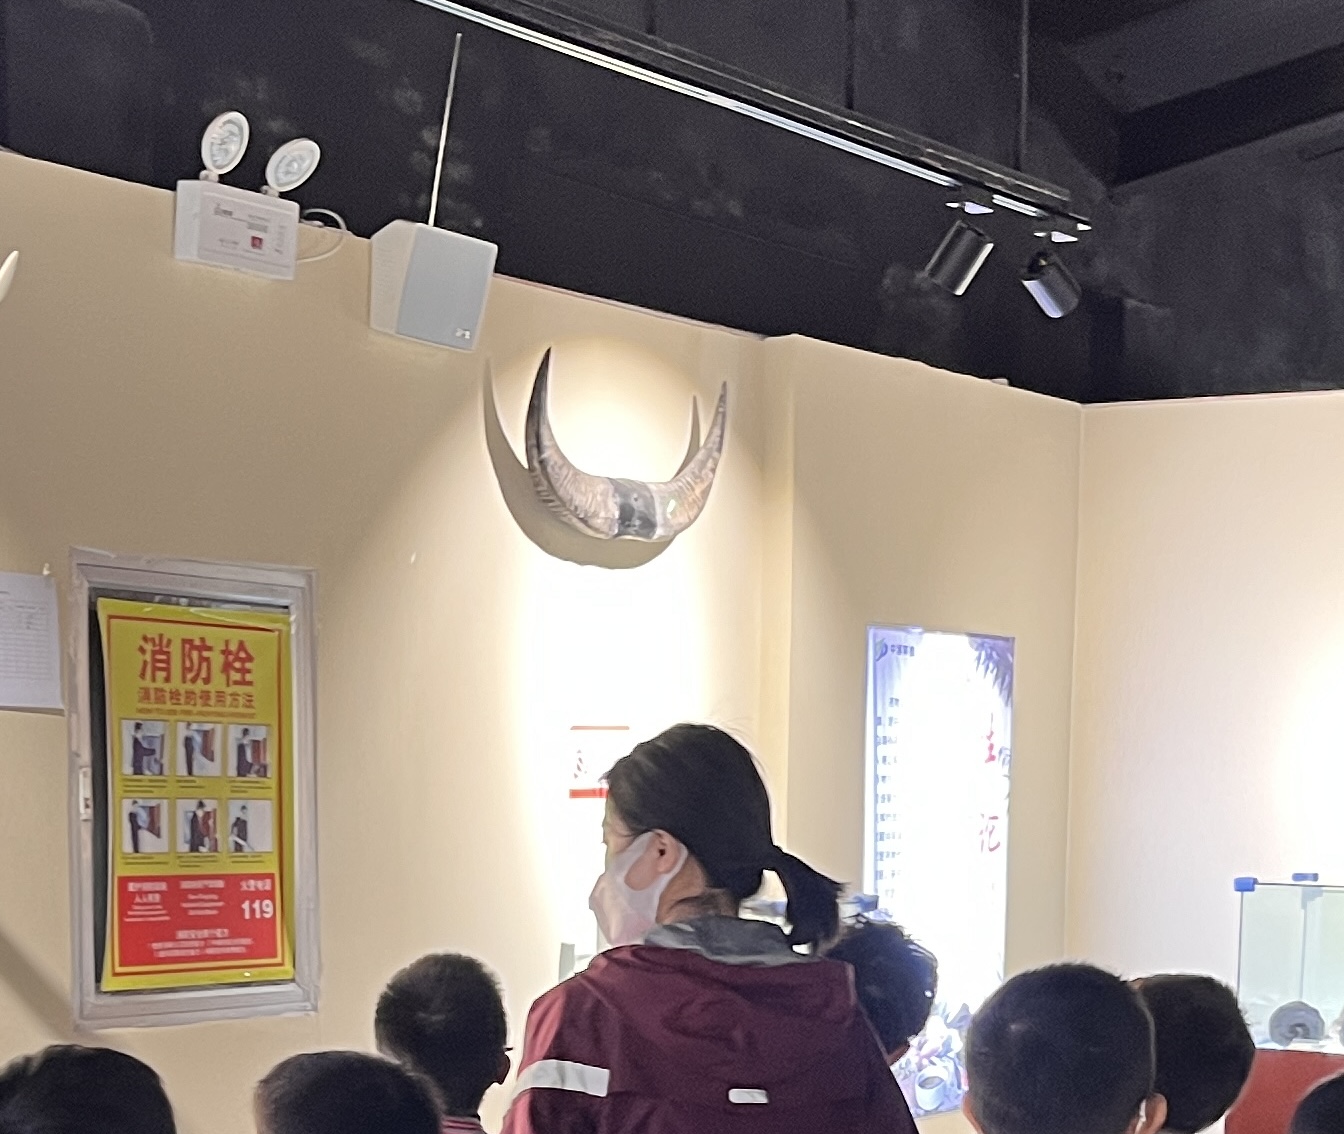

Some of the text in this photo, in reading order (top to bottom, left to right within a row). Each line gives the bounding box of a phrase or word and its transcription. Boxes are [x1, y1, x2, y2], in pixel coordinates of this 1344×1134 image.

[137, 632, 255, 687] 消防栓
[241, 899, 274, 920] 119
